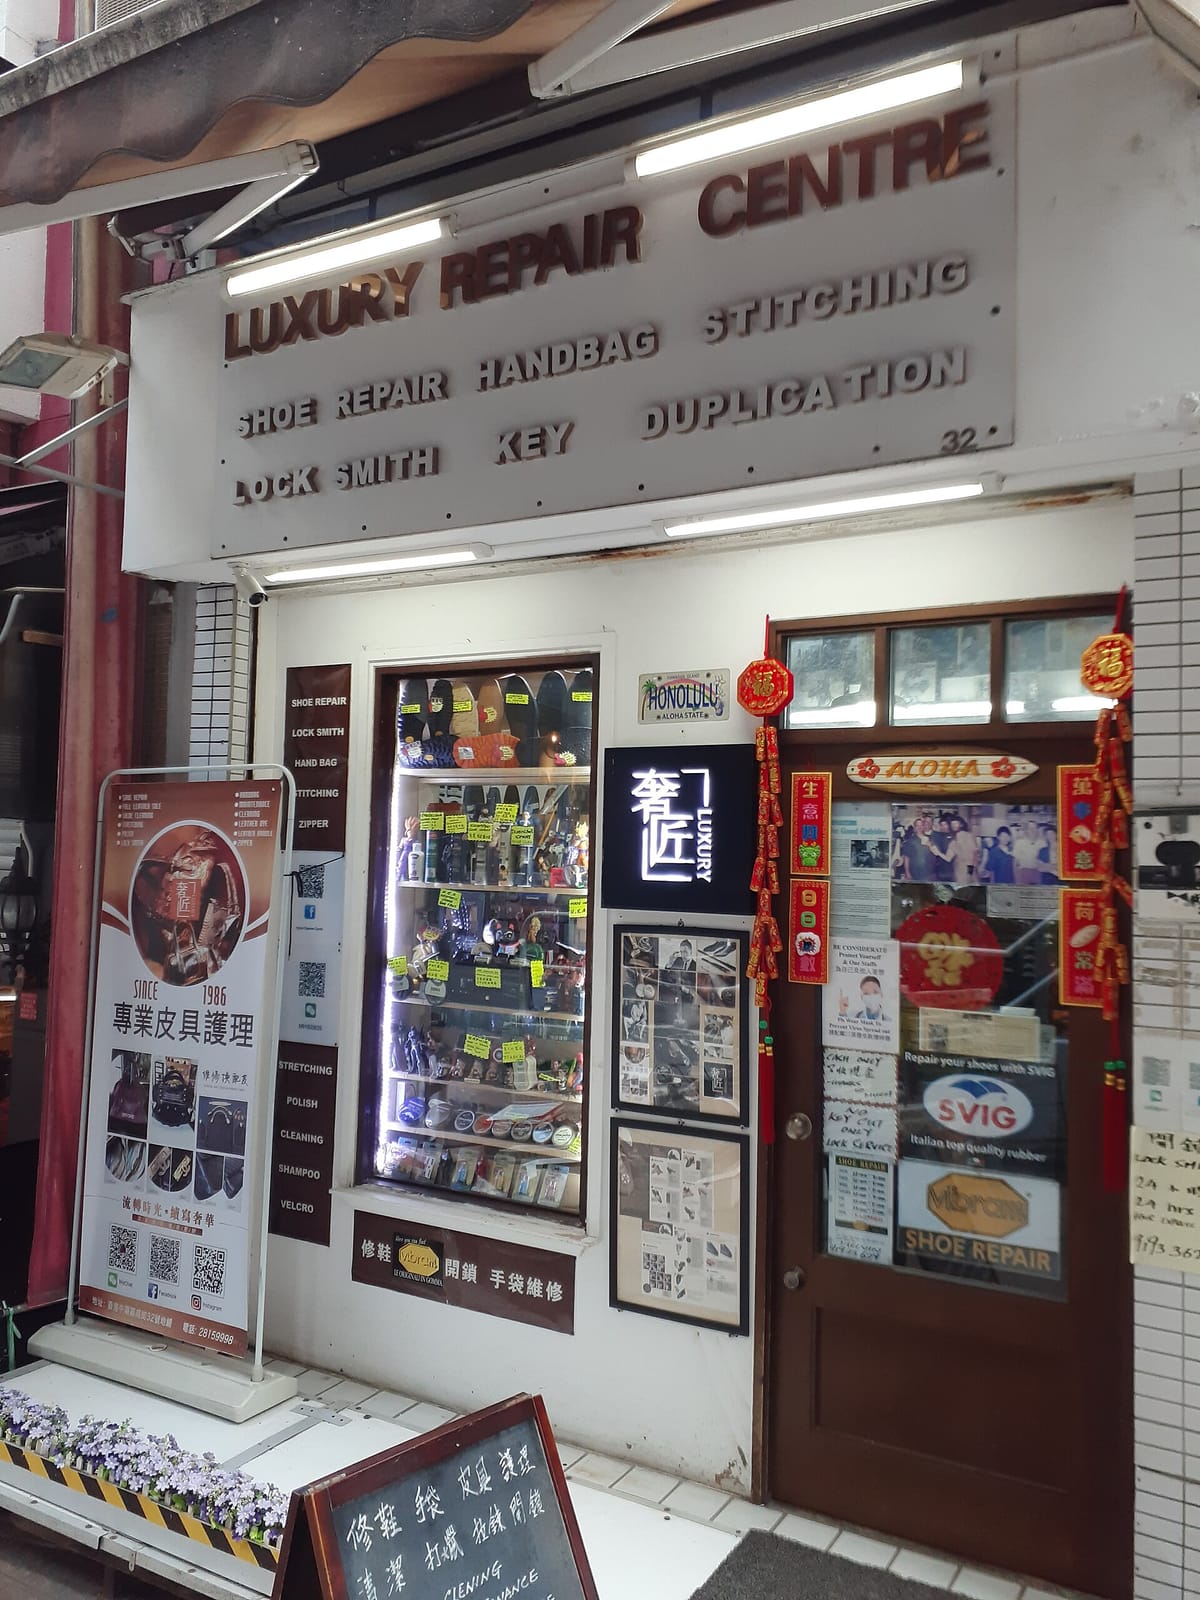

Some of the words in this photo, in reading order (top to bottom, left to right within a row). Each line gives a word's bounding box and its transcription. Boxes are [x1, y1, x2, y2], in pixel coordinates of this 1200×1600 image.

[225, 260, 425, 361] LUXURY
[440, 206, 645, 310] REPAIR
[698, 102, 991, 239] CENTRE
[237, 398, 318, 438] SHOE
[335, 371, 449, 419] REPAIR
[477, 323, 659, 393] HANDBAG
[703, 255, 969, 345] STITCHING
[233, 466, 320, 506] LOCK
[335, 446, 439, 490] SMITH
[497, 421, 574, 466] KEY
[640, 344, 967, 441] DUPLICATION
[940, 426, 978, 454] 32
[291, 698, 313, 708] SHOE
[314, 697, 347, 707] REPAIR
[648, 681, 720, 711] HONOLULU
[662, 712, 684, 720] ALOHA
[684, 711, 704, 719] STATE
[292, 728, 315, 738] LOCK
[316, 727, 345, 737] SMITH
[294, 759, 318, 768] HAND
[319, 758, 338, 768] BAG
[884, 758, 980, 779] ALOHA
[295, 789, 340, 798] TITCHING
[298, 819, 329, 829] ZIPPER
[696, 808, 713, 883] LUXURY
[132, 979, 159, 1001] SINCE
[202, 984, 227, 1006] 1986
[112, 1001, 254, 1048] 專業皮具護理
[278, 1060, 333, 1076] STRETCHING
[904, 1051, 939, 1066] Repair
[940, 1056, 965, 1069] your
[967, 1058, 1000, 1072] shoes
[1000, 1062, 1026, 1074] with
[286, 1096, 318, 1109] POLISH
[938, 1098, 1017, 1130] SVIG
[828, 1111, 851, 1123] KEY
[280, 1129, 324, 1145] CLEANING
[910, 1134, 944, 1149] Italian
[946, 1139, 965, 1153] top
[966, 1142, 1004, 1161] quality
[1007, 1147, 1048, 1163] rubber
[278, 1164, 321, 1180] SHAMPOO
[280, 1200, 314, 1214] VELCRO
[361, 1239, 392, 1264] 修鞋
[905, 1228, 966, 1258] SHOE
[972, 1240, 1051, 1272] REPAIR
[444, 1258, 478, 1284] 開鎖
[489, 1269, 563, 1302] 手袋維修
[198, 1326, 234, 1345] 28159998
[346, 1502, 402, 1553] 修鞋
[457, 1456, 493, 1500] 皮具
